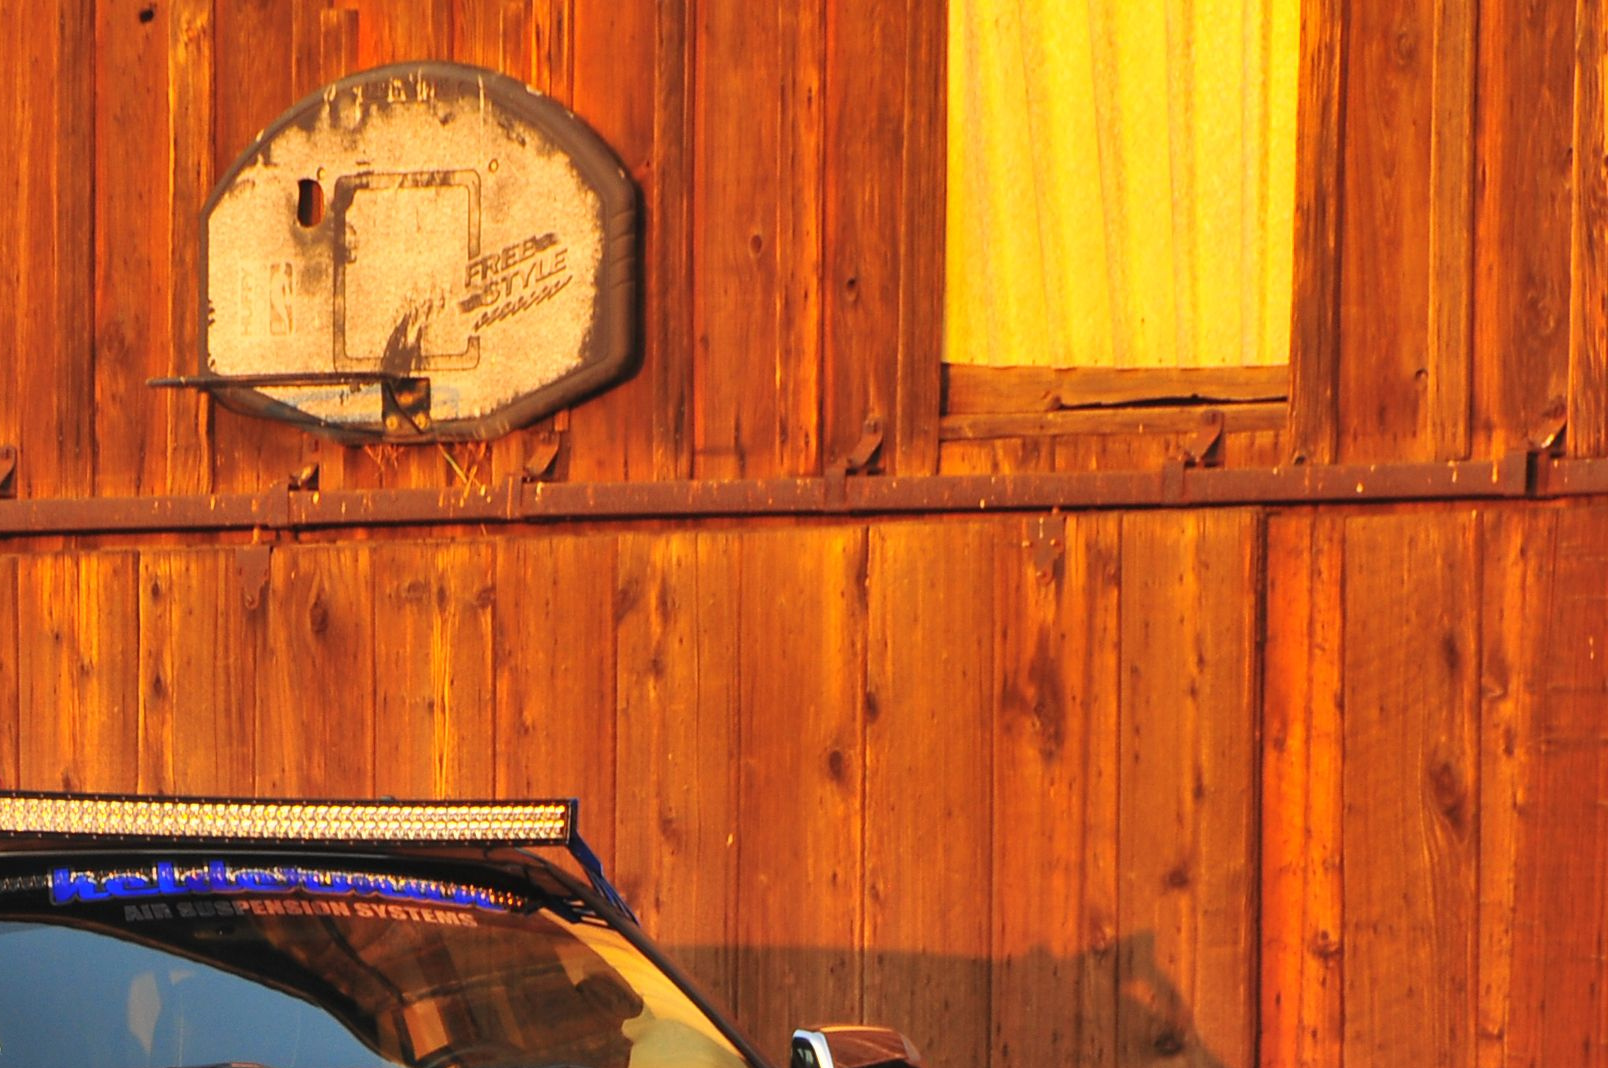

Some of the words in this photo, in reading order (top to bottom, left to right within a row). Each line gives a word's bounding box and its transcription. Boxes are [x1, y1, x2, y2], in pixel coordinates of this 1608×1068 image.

[482, 247, 569, 307] STYLE
[124, 901, 174, 922] AIR
[177, 899, 351, 918] SUSPENSION
[353, 902, 478, 928] SYSTEMS
